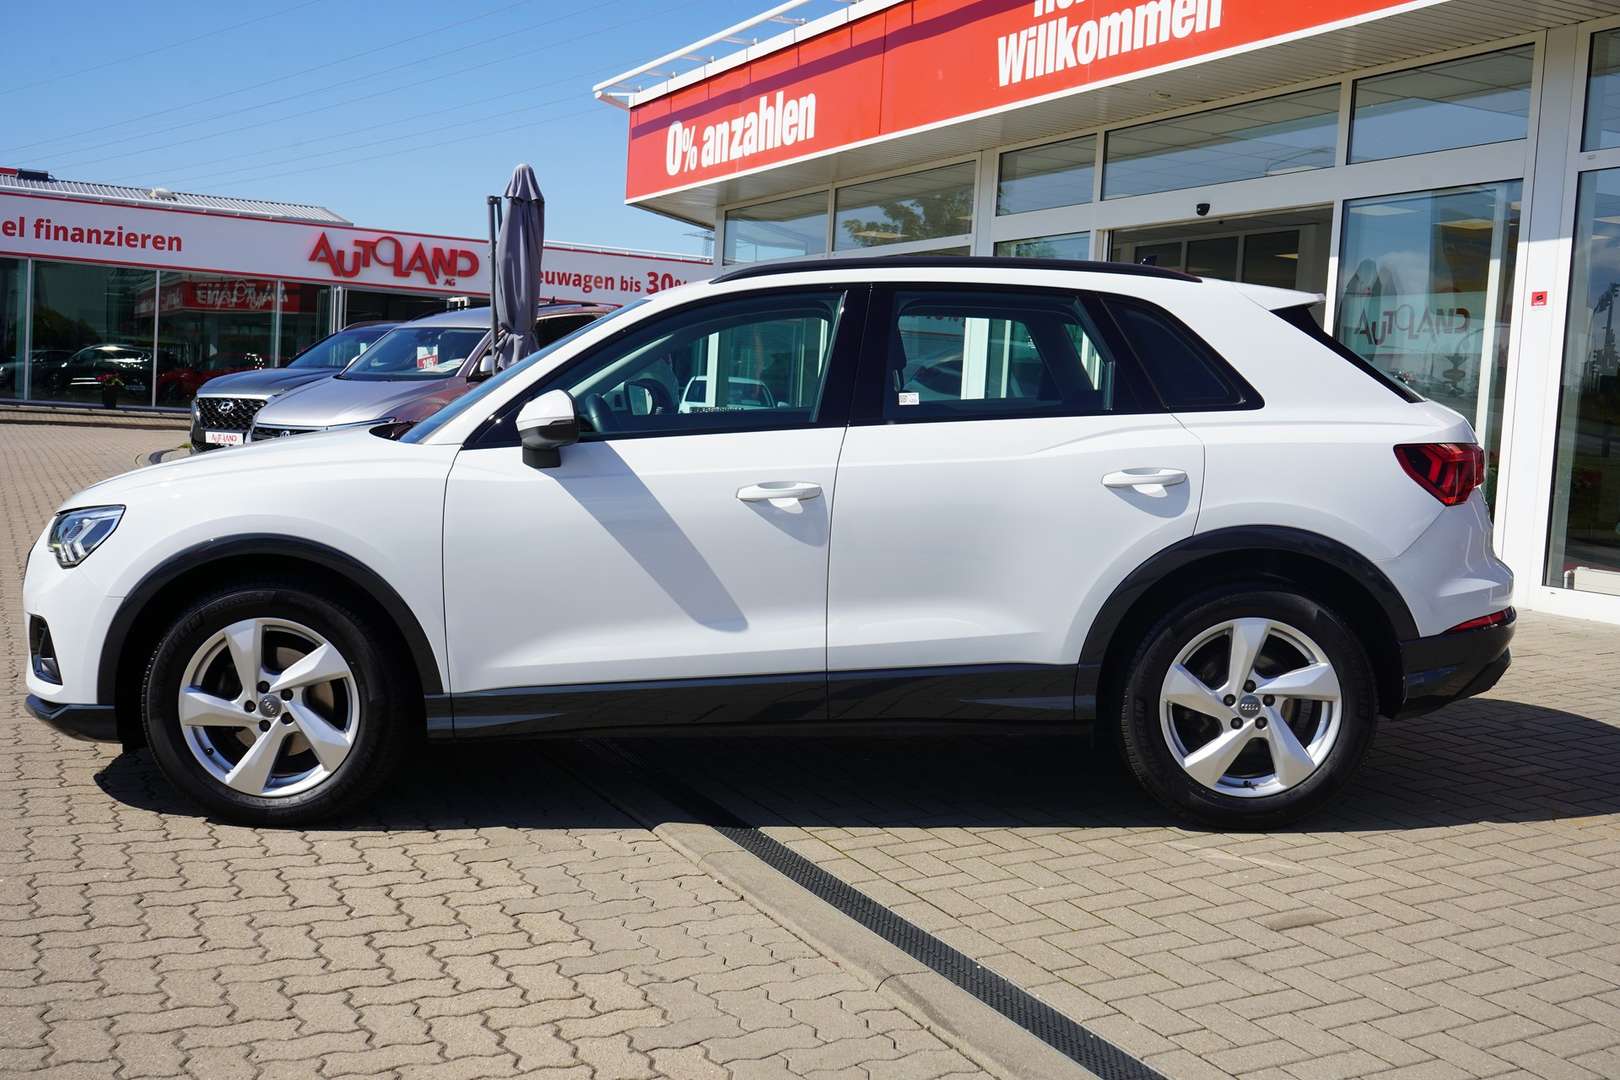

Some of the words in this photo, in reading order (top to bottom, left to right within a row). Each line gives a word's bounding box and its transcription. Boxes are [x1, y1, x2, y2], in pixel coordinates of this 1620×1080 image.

[997, 0, 1223, 88] Willkommen
[666, 120, 698, 176] 0%
[701, 90, 817, 168] anzahlen
[1, 216, 26, 238] el
[34, 218, 182, 252] finanzieren
[308, 232, 480, 285] AUTOLAND
[443, 278, 456, 287] AG
[620, 275, 641, 293] bis
